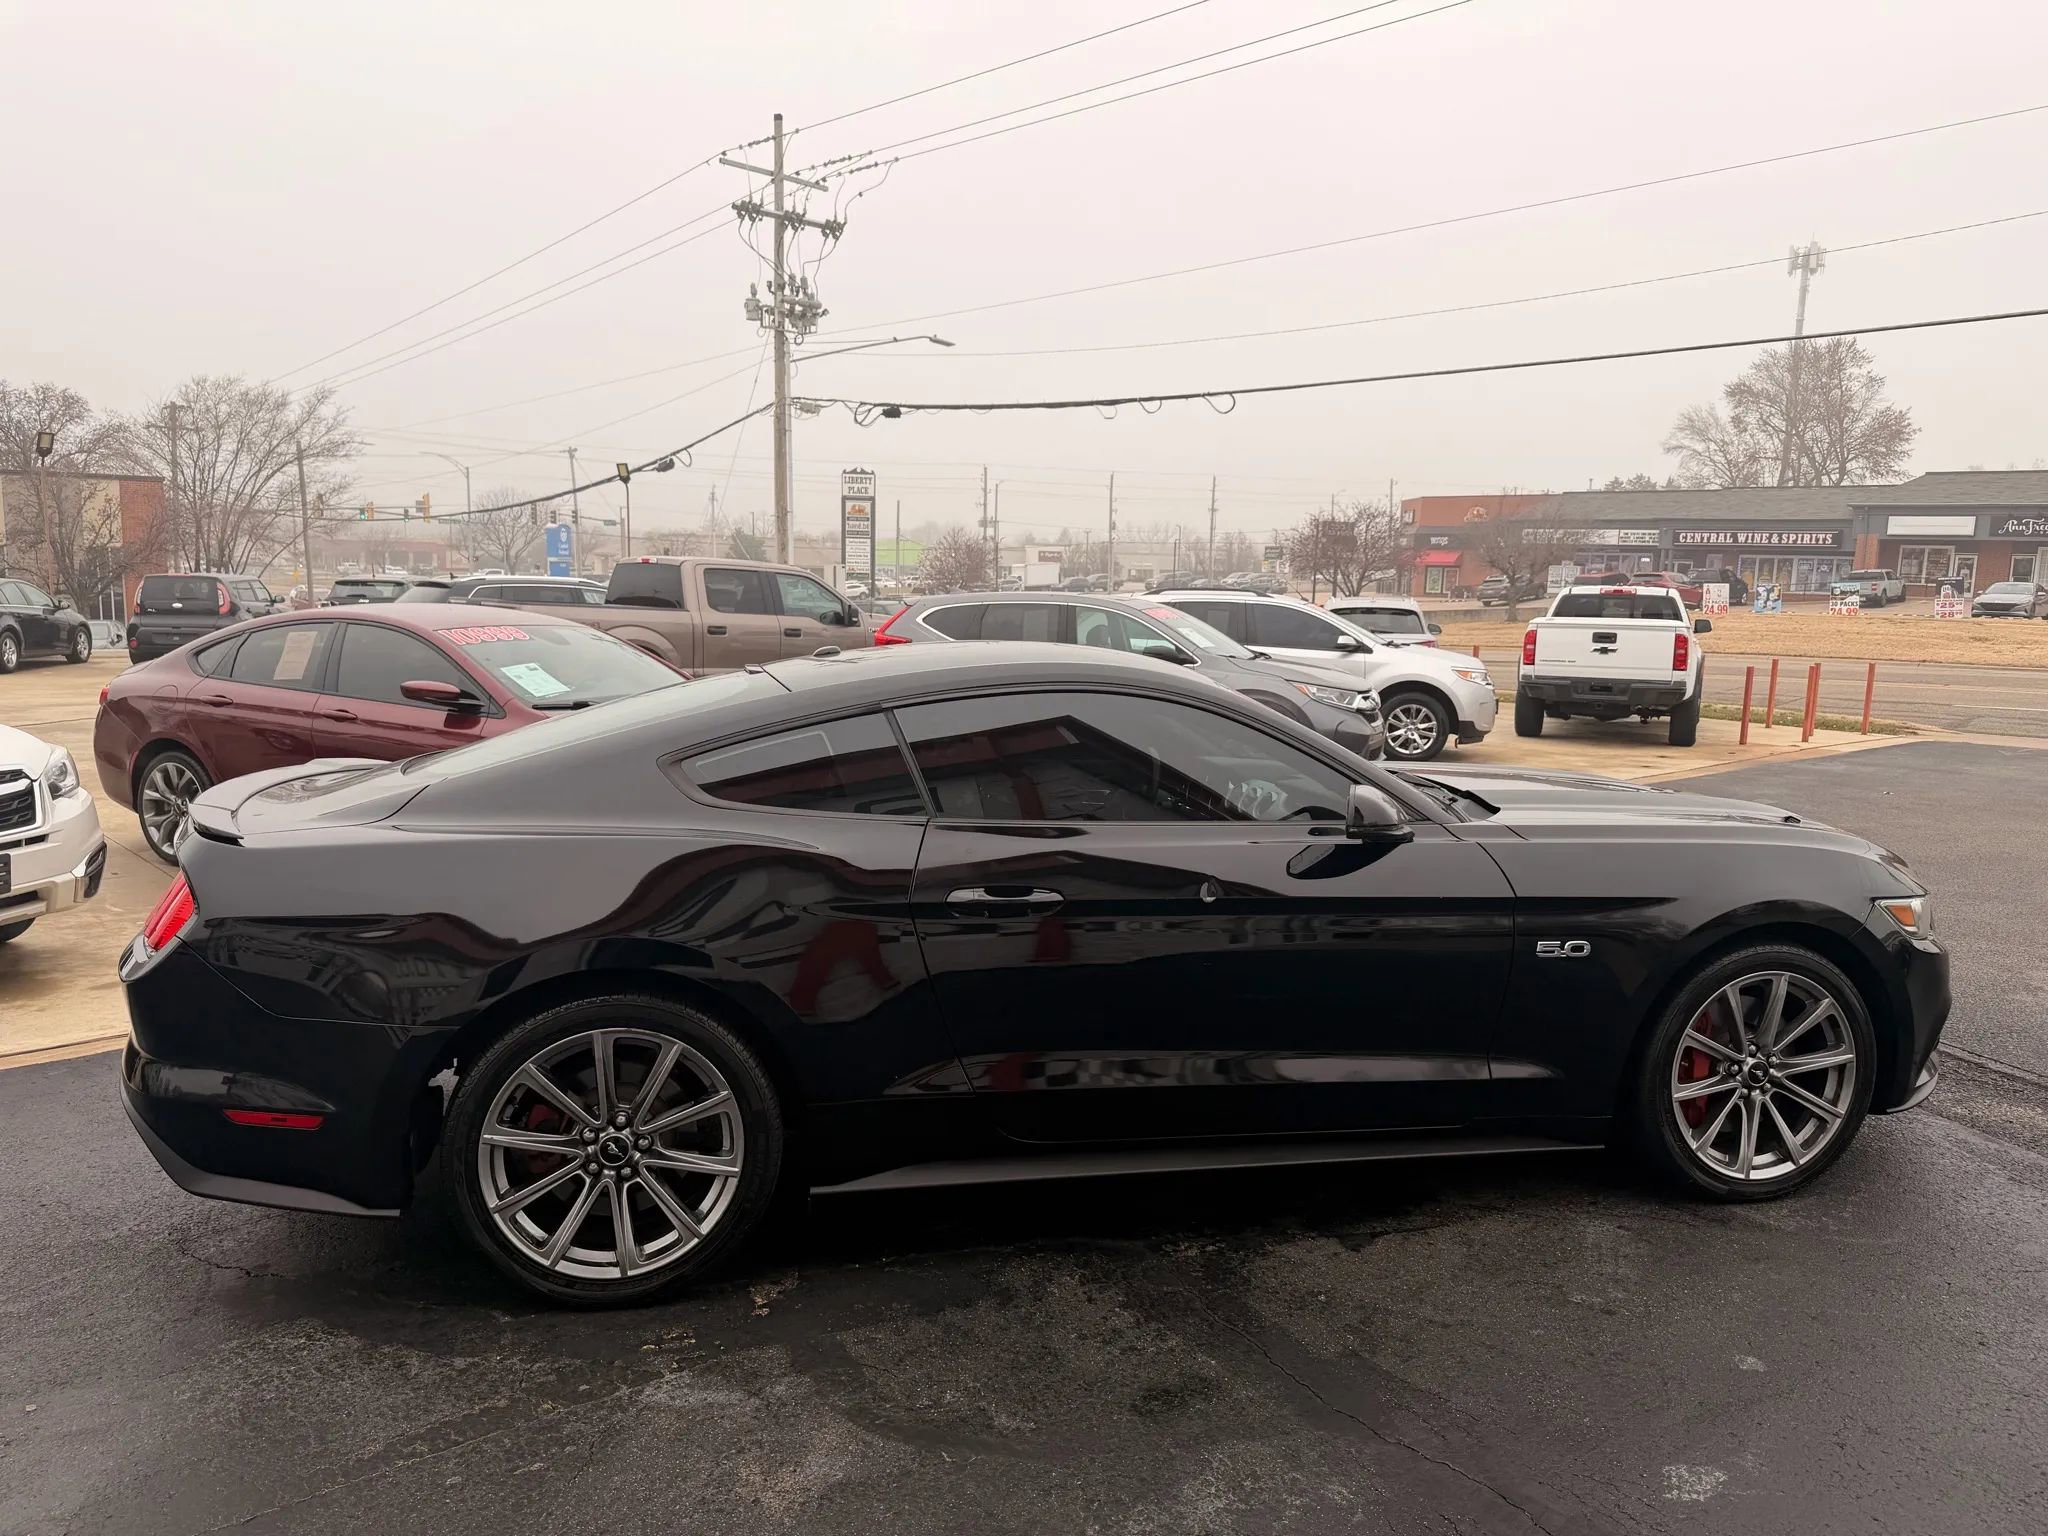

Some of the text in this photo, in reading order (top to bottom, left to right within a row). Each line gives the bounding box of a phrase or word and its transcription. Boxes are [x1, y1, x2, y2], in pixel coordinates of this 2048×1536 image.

[844, 476, 873, 485] LIBERTY
[848, 486, 870, 495] PLACE
[1679, 532, 1733, 543] CENTRAL
[1737, 532, 1769, 544] WINE
[1781, 533, 1833, 545] SPIRITS
[1704, 604, 1728, 615] 24.99
[1536, 940, 1591, 958] 5.0
